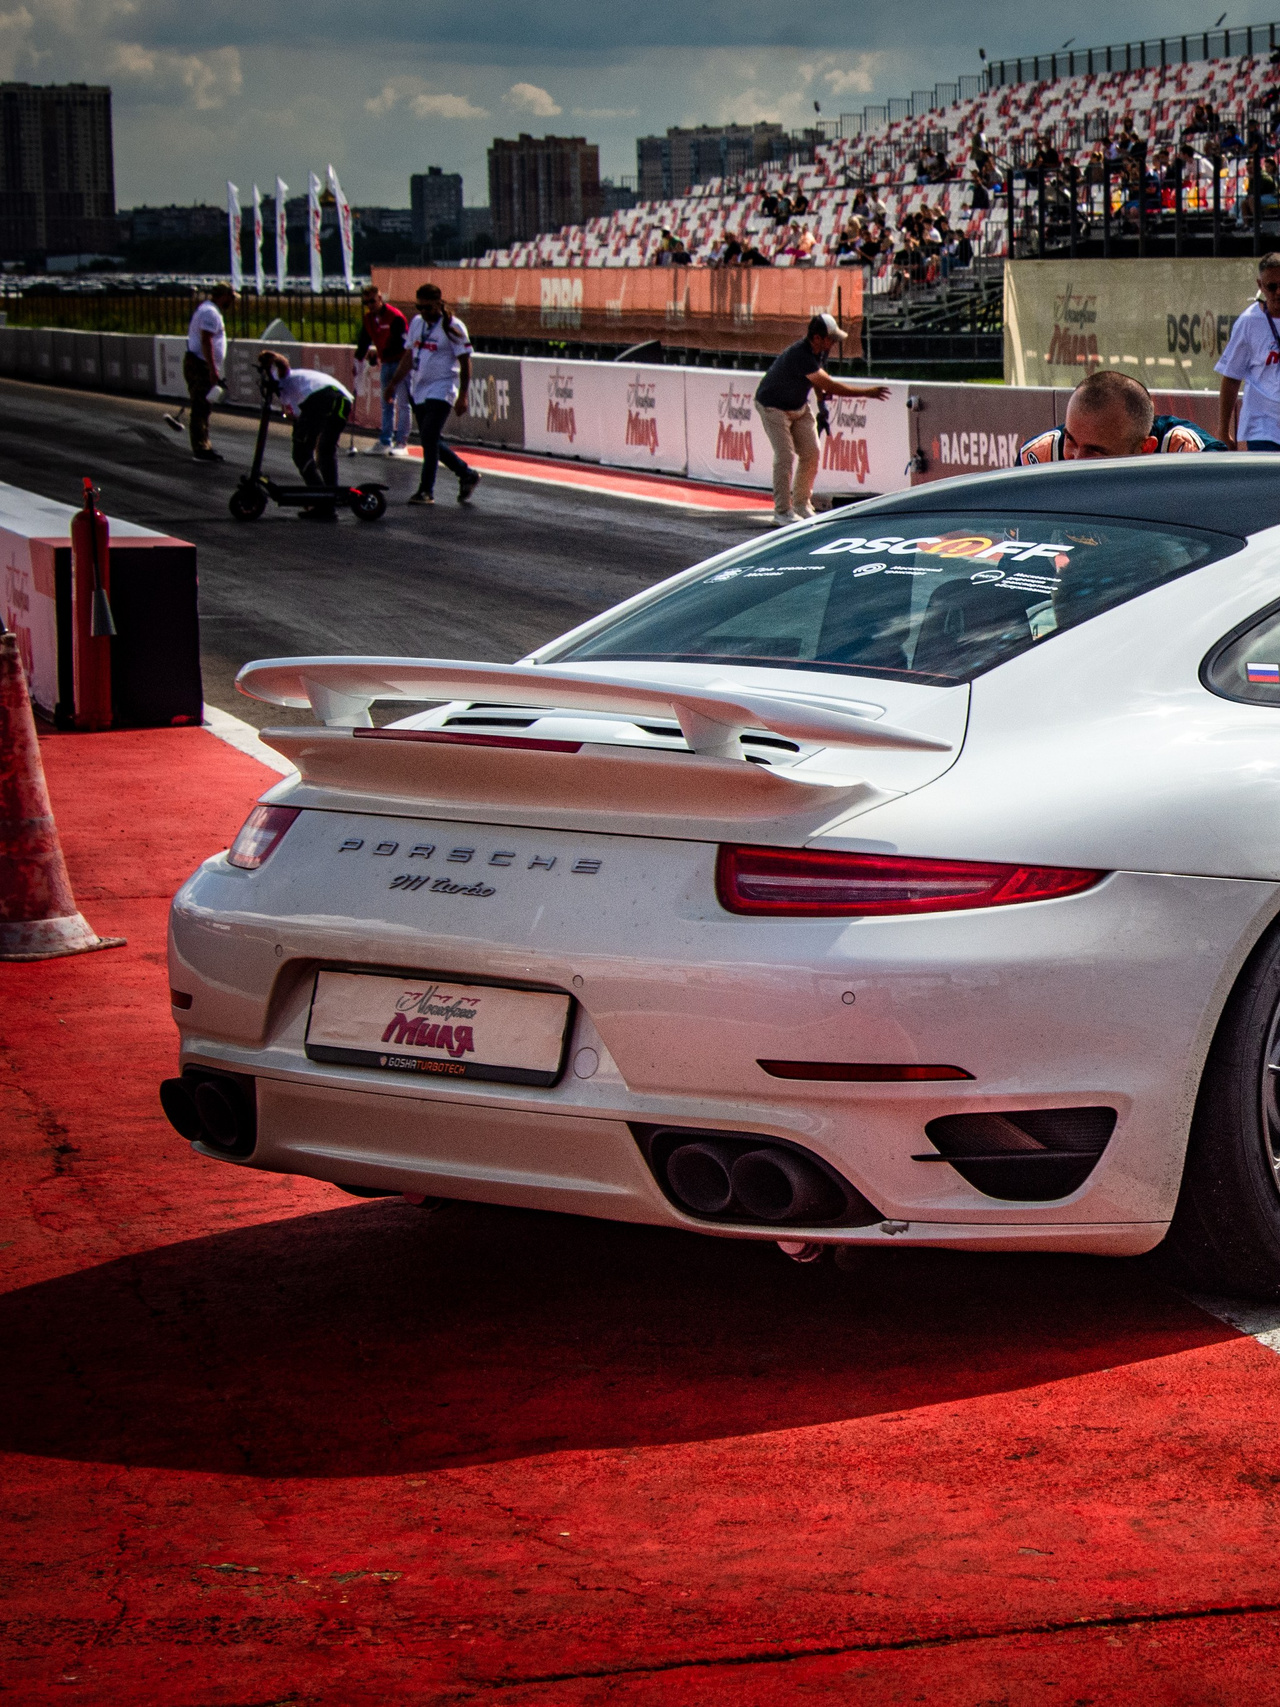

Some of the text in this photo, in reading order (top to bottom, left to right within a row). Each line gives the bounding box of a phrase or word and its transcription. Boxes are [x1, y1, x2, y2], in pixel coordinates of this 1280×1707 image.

[940, 432, 1019, 468] RACEPARK
[338, 838, 602, 875] PORSCHE
[381, 1012, 475, 1058] Миля
